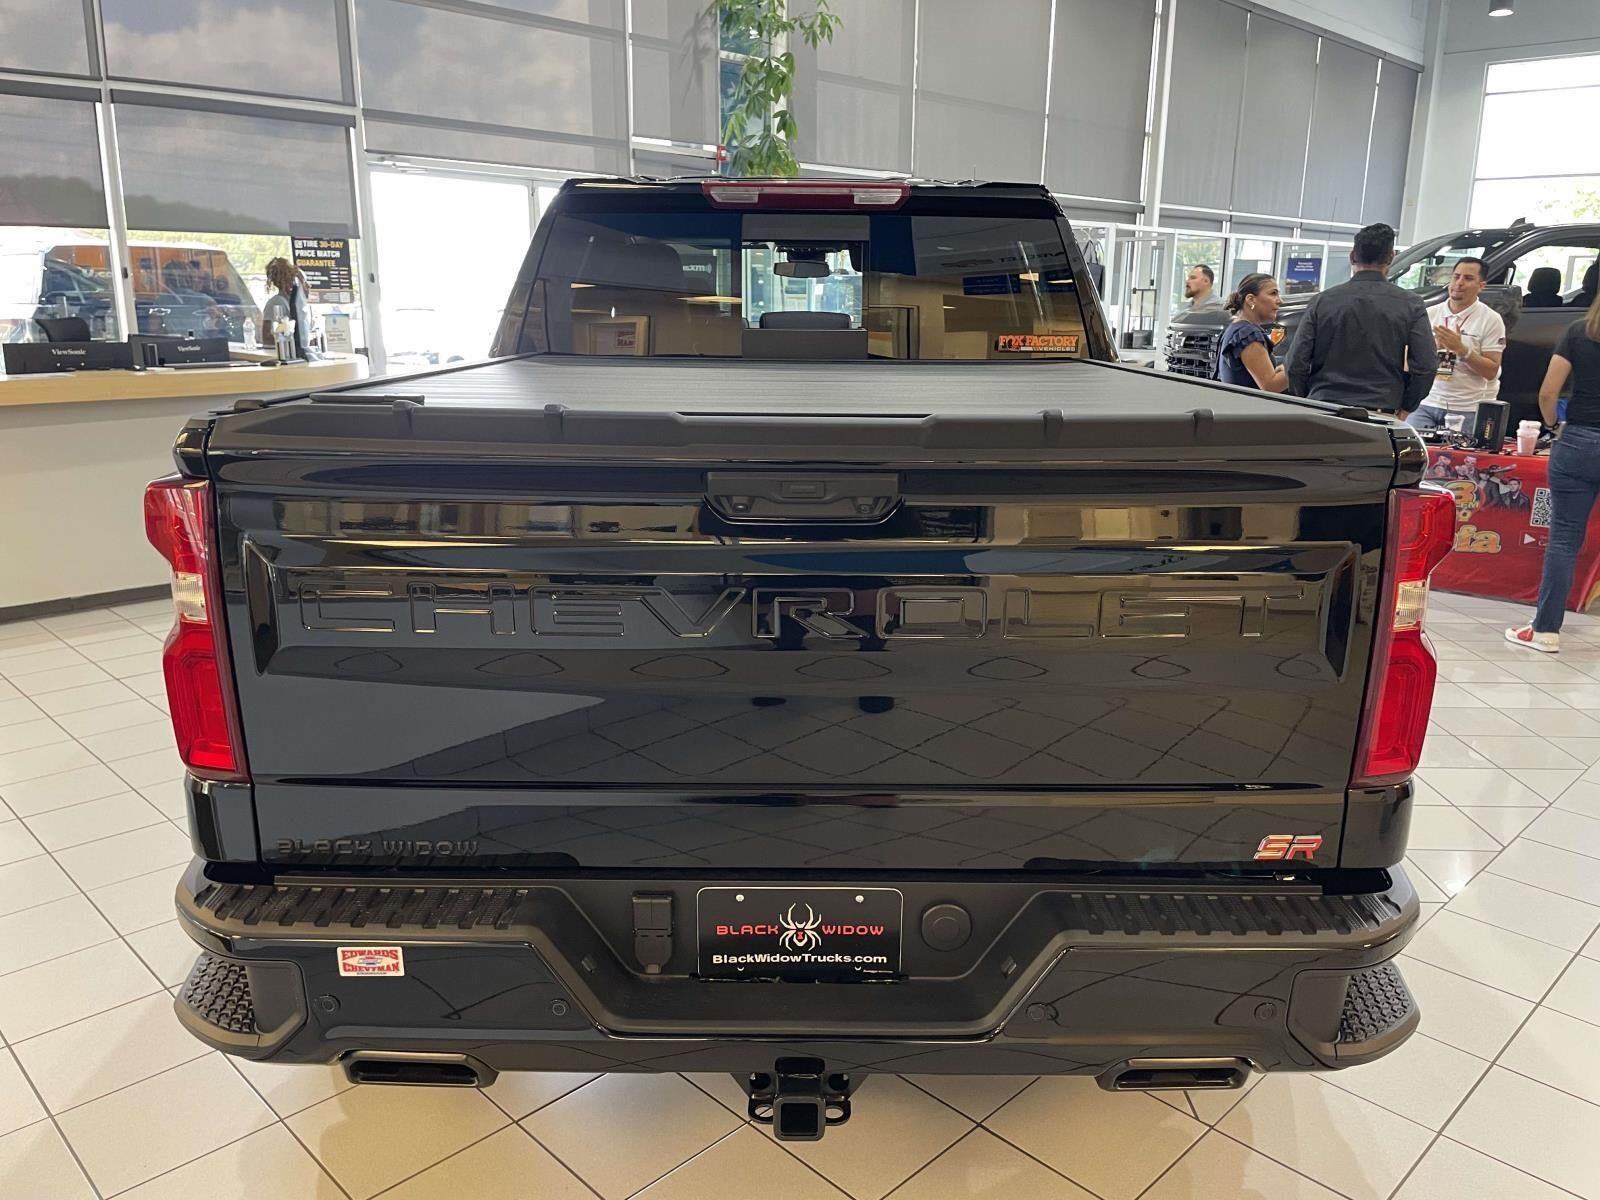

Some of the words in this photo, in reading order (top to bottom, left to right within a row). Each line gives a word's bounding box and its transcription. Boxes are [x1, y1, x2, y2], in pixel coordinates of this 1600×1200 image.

[295, 250, 316, 258] PRICE
[317, 250, 341, 258] MATCH
[296, 259, 337, 267] GUARANTEE
[1000, 335, 1025, 349] FOX
[1026, 335, 1079, 347] FACTORY
[51, 348, 87, 356] ViewSonic
[300, 582, 1303, 638] CHEVROLET
[276, 838, 372, 854] BLACK
[383, 839, 480, 856] WIDOW
[716, 924, 779, 936] BLACK
[821, 925, 884, 936] WIDOW
[341, 949, 399, 960] EDWARDS
[712, 953, 888, 964] BlackWidowTrucks.com
[342, 961, 400, 972] CHEVYMAN
